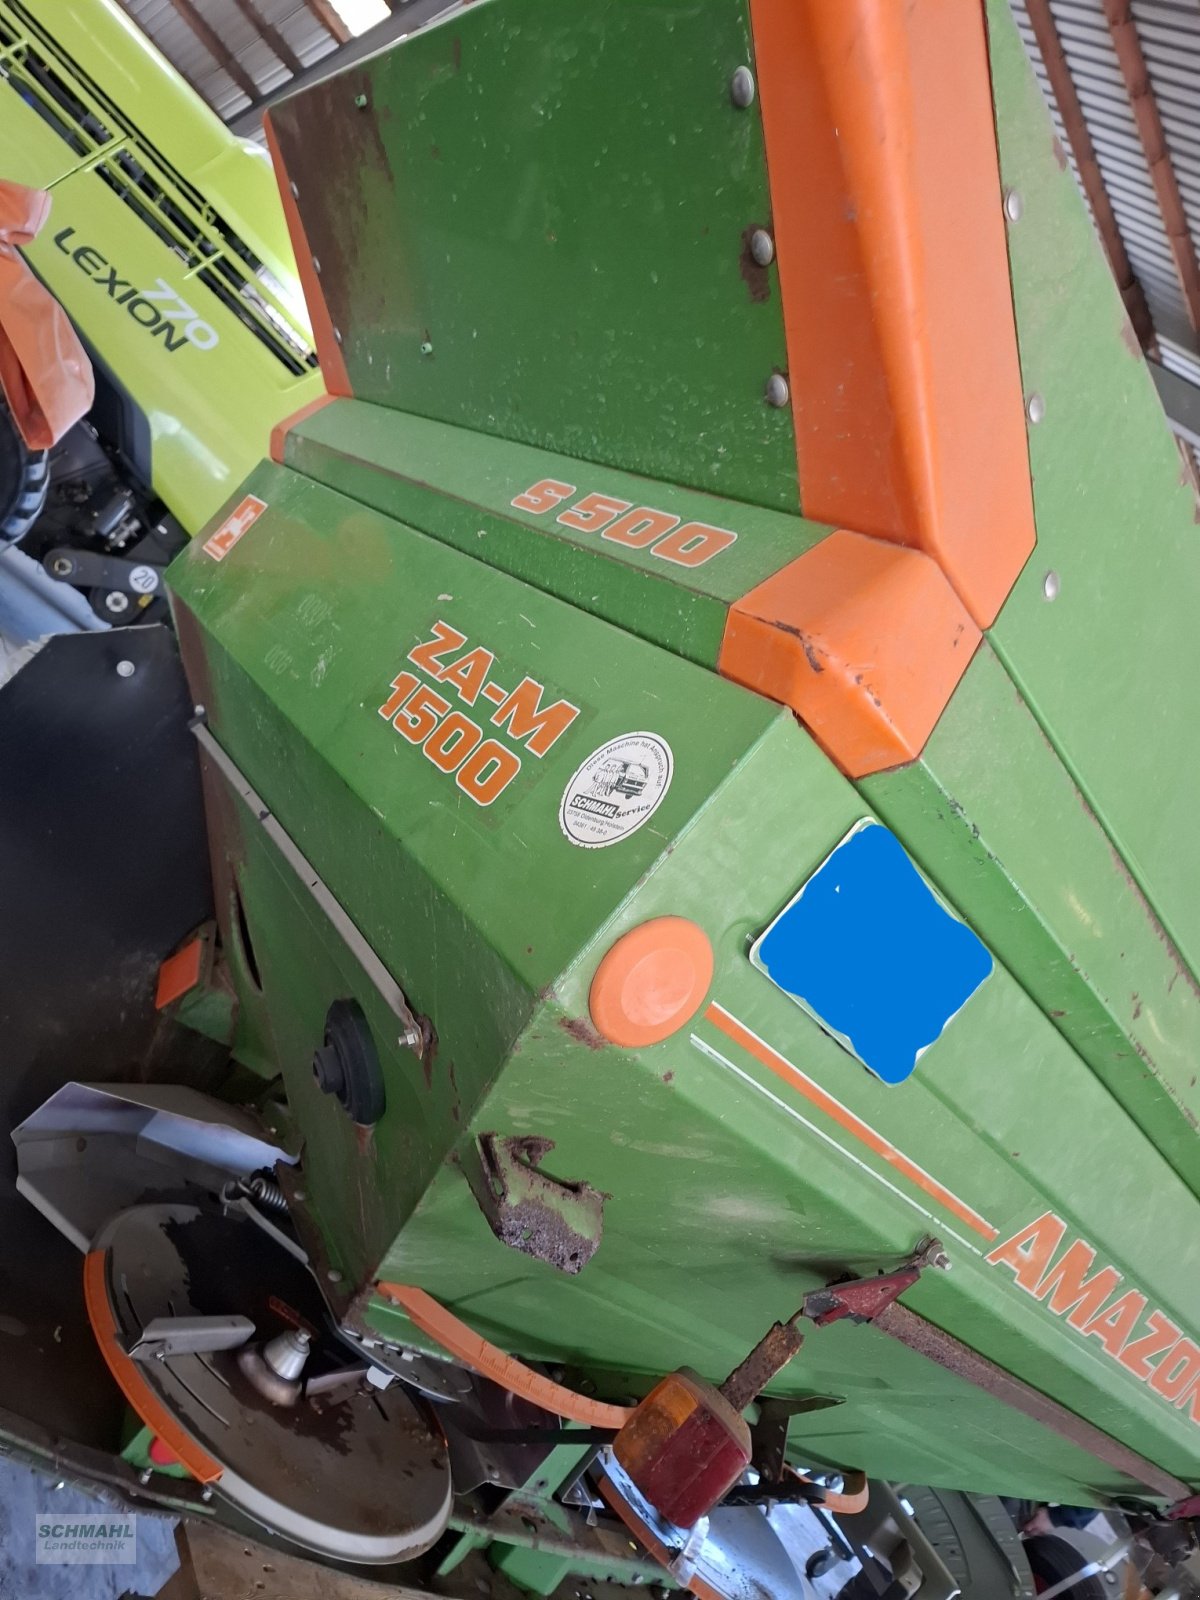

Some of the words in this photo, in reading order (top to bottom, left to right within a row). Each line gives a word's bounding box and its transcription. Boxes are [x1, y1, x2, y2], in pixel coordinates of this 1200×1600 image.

[53, 226, 190, 352] LEXION
[142, 278, 219, 350] 770
[511, 478, 577, 515] S
[556, 492, 738, 568] 500
[133, 569, 156, 589] 20
[407, 619, 581, 758] ZA-M
[378, 671, 521, 807] 1500
[586, 754, 605, 771] Diese
[606, 740, 640, 755] Maschine
[570, 795, 618, 818] SCHMAHL
[615, 804, 651, 819] Service
[984, 1210, 1200, 1426] AMAZO
